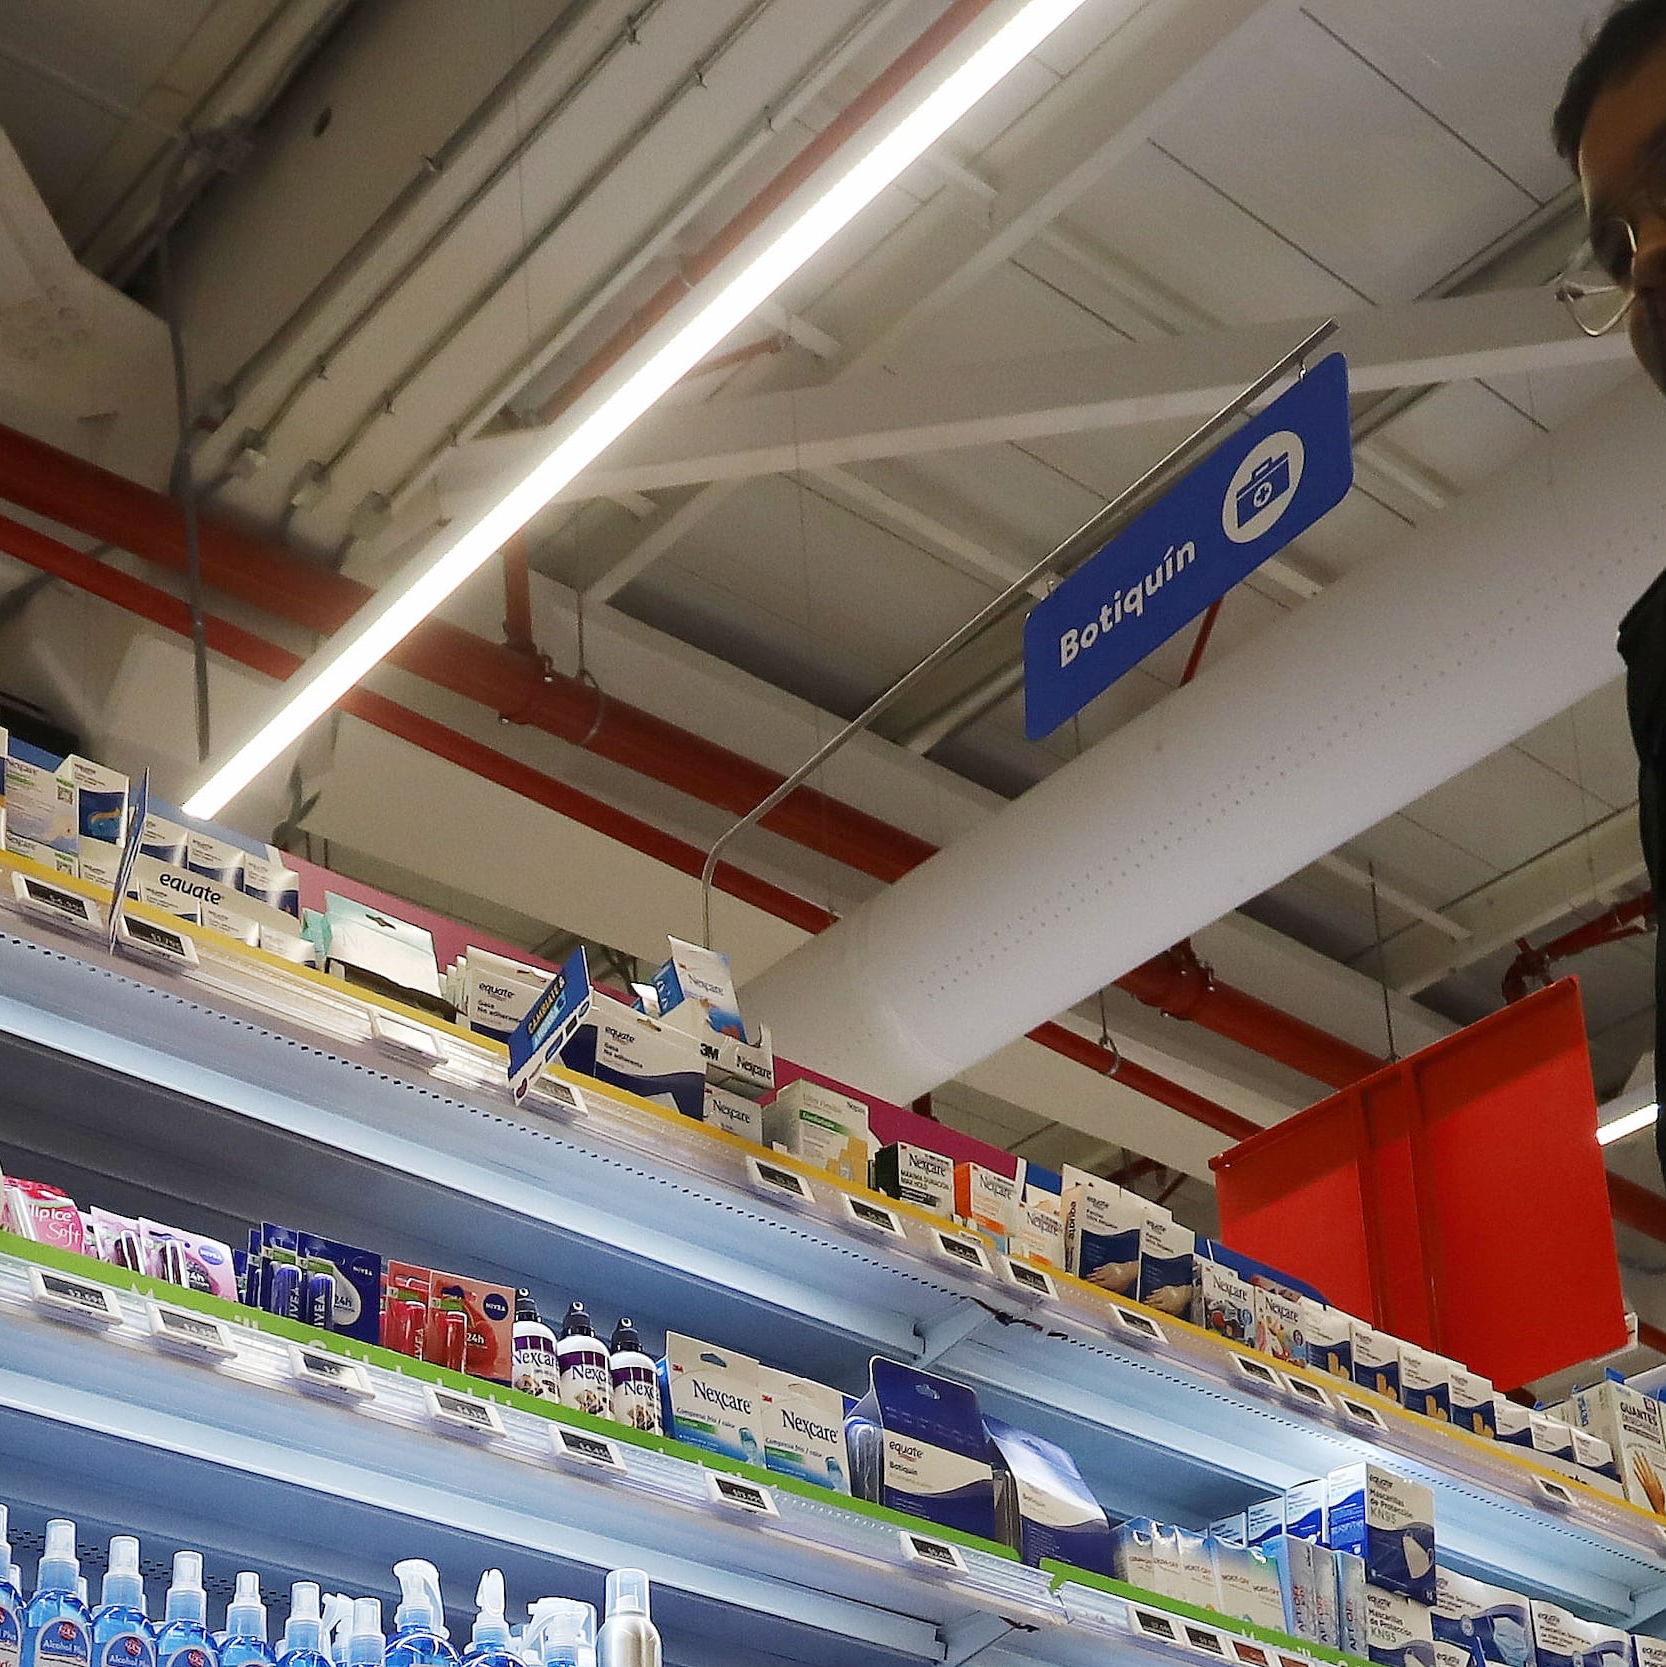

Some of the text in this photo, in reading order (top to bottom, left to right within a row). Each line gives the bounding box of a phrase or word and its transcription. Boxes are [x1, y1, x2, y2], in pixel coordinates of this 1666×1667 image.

[1060, 539, 1195, 668] Botiquín
[160, 872, 221, 906] equate
[479, 982, 514, 999] equate
[605, 1025, 635, 1043] equate
[701, 1043, 719, 1062] 3M
[737, 1055, 771, 1080] Nexcare
[713, 1100, 750, 1124] Nexcare
[908, 1152, 947, 1177] Nexcare
[47, 1221, 81, 1244] Soft
[1068, 1200, 1077, 1241] equate
[1213, 1275, 1248, 1302] Nexcare
[485, 1302, 506, 1312] NIVEA
[1265, 1297, 1299, 1322] Nexcare
[466, 1333, 484, 1345] 24h
[693, 1379, 752, 1414] Nexcare
[782, 1409, 838, 1444] Nexcare
[1620, 1401, 1658, 1427] GUANTES
[889, 1440, 923, 1459] equate
[1369, 1473, 1393, 1489] equate
